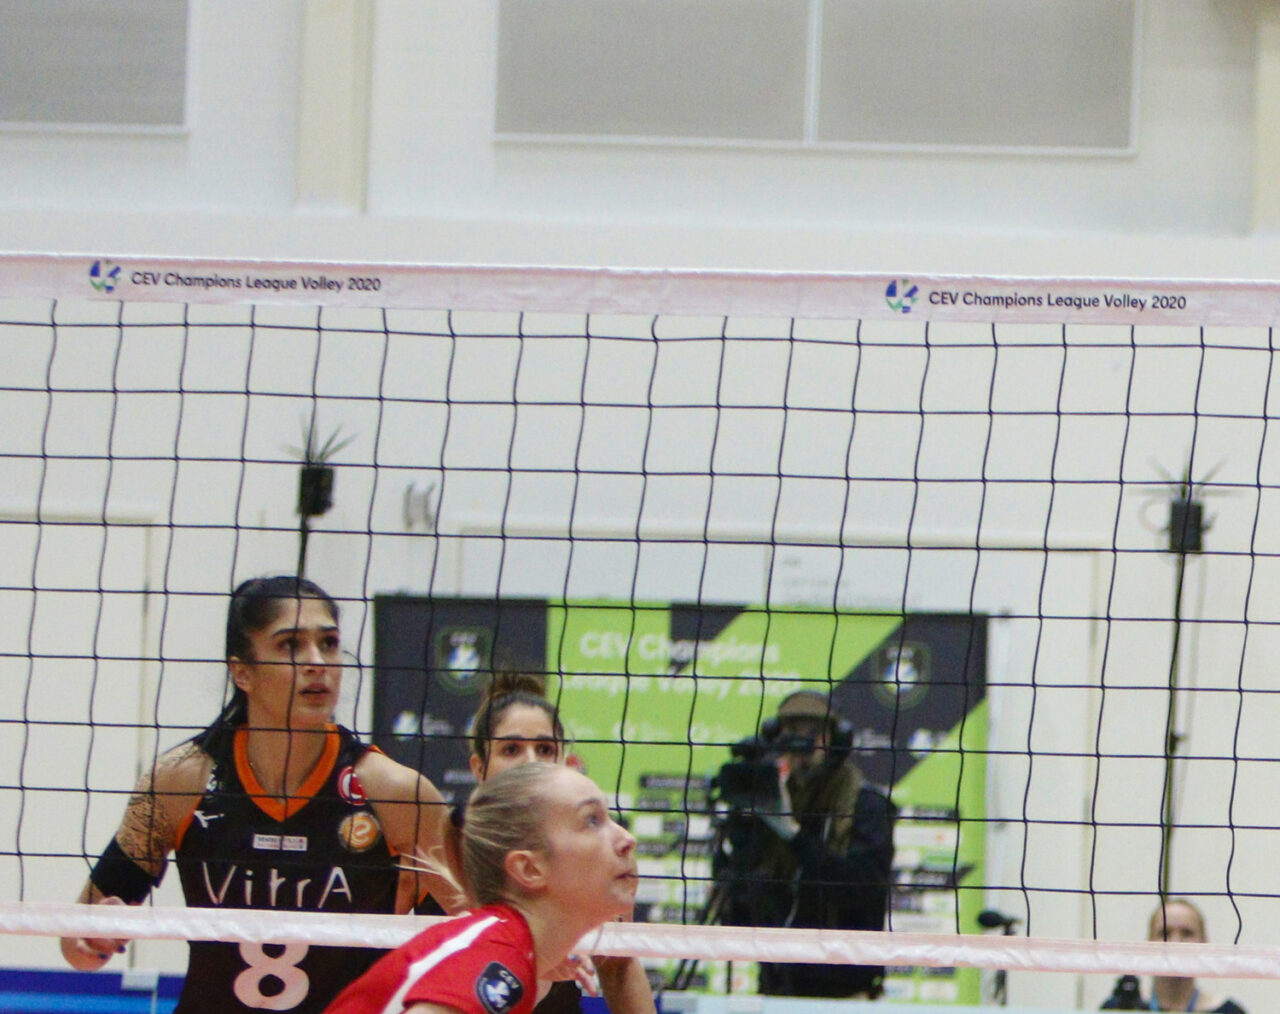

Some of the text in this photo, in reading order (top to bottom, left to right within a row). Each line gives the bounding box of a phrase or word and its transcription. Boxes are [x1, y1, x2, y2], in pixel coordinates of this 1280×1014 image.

[131, 271, 382, 294] CEV Champions League Volley 2020
[928, 291, 1187, 312] CEV Champions League Volley 2020
[579, 631, 632, 660] CEV
[202, 861, 352, 909] VitrA
[232, 940, 310, 1012] 8
